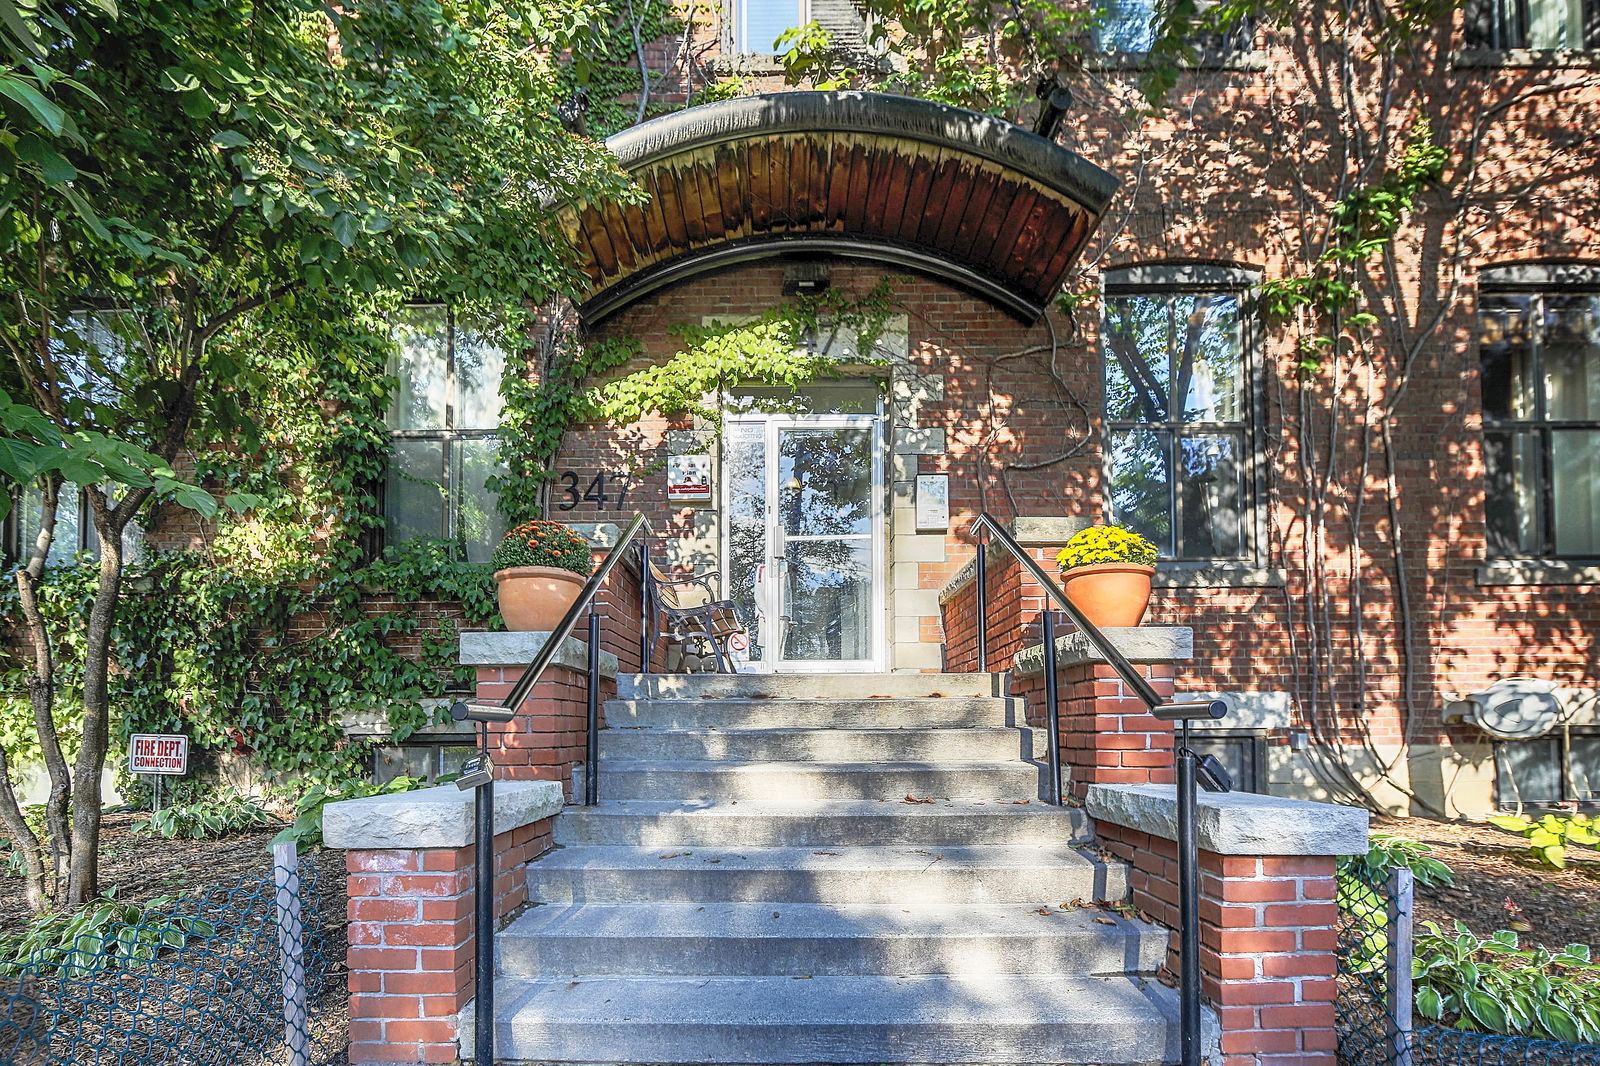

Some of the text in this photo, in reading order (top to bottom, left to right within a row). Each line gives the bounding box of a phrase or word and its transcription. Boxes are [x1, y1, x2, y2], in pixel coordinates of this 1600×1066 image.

[559, 470, 632, 511] 347
[135, 740, 182, 757] FIRE DEPT.
[134, 756, 182, 768] CONNECTION
